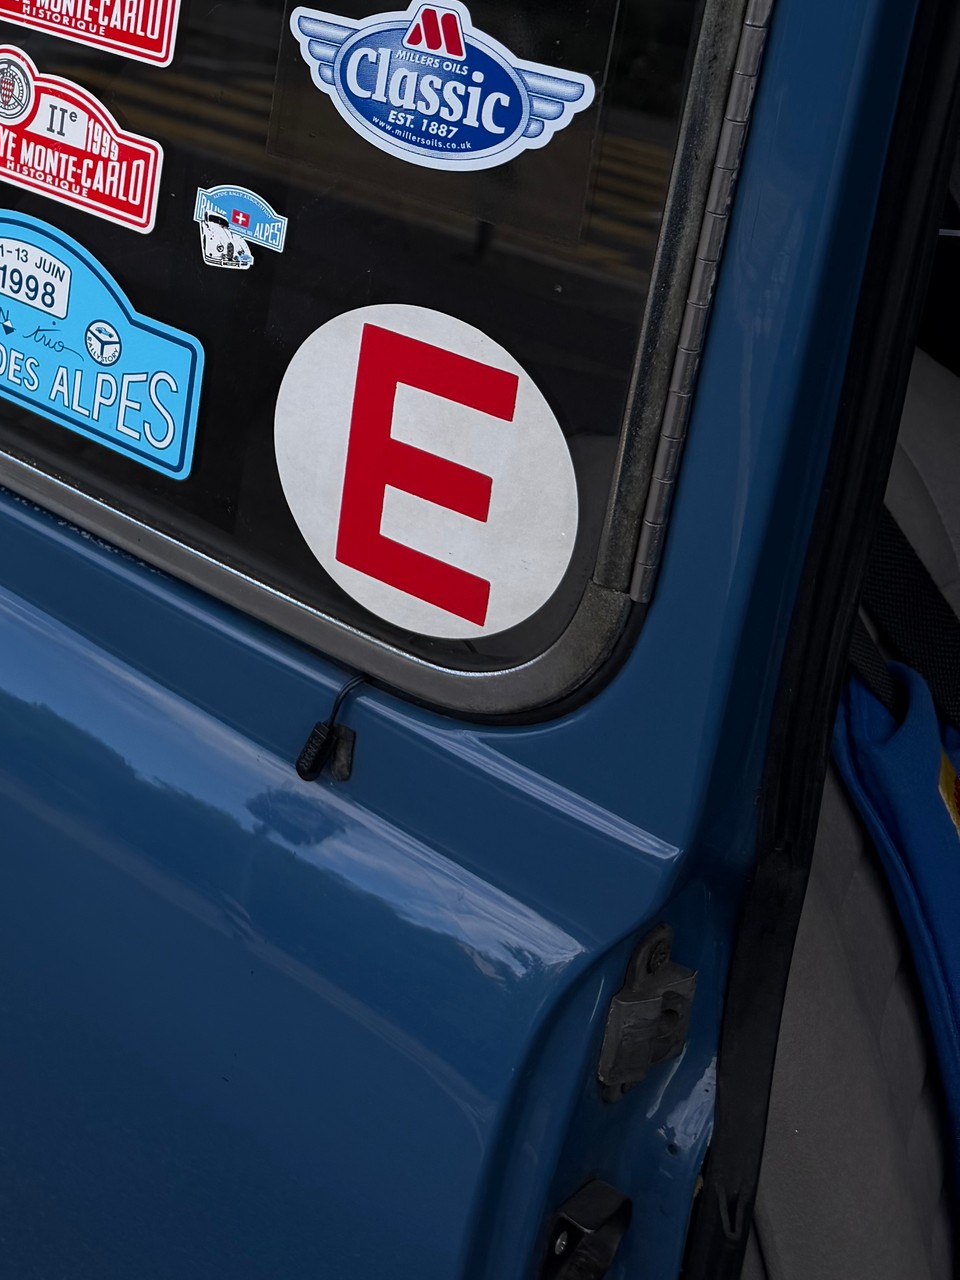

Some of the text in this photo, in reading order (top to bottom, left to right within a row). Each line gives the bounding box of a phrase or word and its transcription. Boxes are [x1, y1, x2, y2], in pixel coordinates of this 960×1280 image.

[22, 3, 106, 36] HISTORIQUE
[394, 49, 469, 76] MILLERS OILS
[346, 47, 511, 135] Classic
[88, 118, 119, 162] 1999
[372, 115, 472, 150] www.millersoils.co.uk
[387, 110, 459, 139] EST. 1887
[6, 160, 89, 198] HISTORIQUE
[19, 137, 146, 206] MONTE-CARLO
[253, 222, 281, 246] ALPES
[0, 264, 56, 310] 1998
[34, 256, 66, 283] JUIN
[49, 368, 179, 451] ALPES
[335, 322, 519, 627] E
